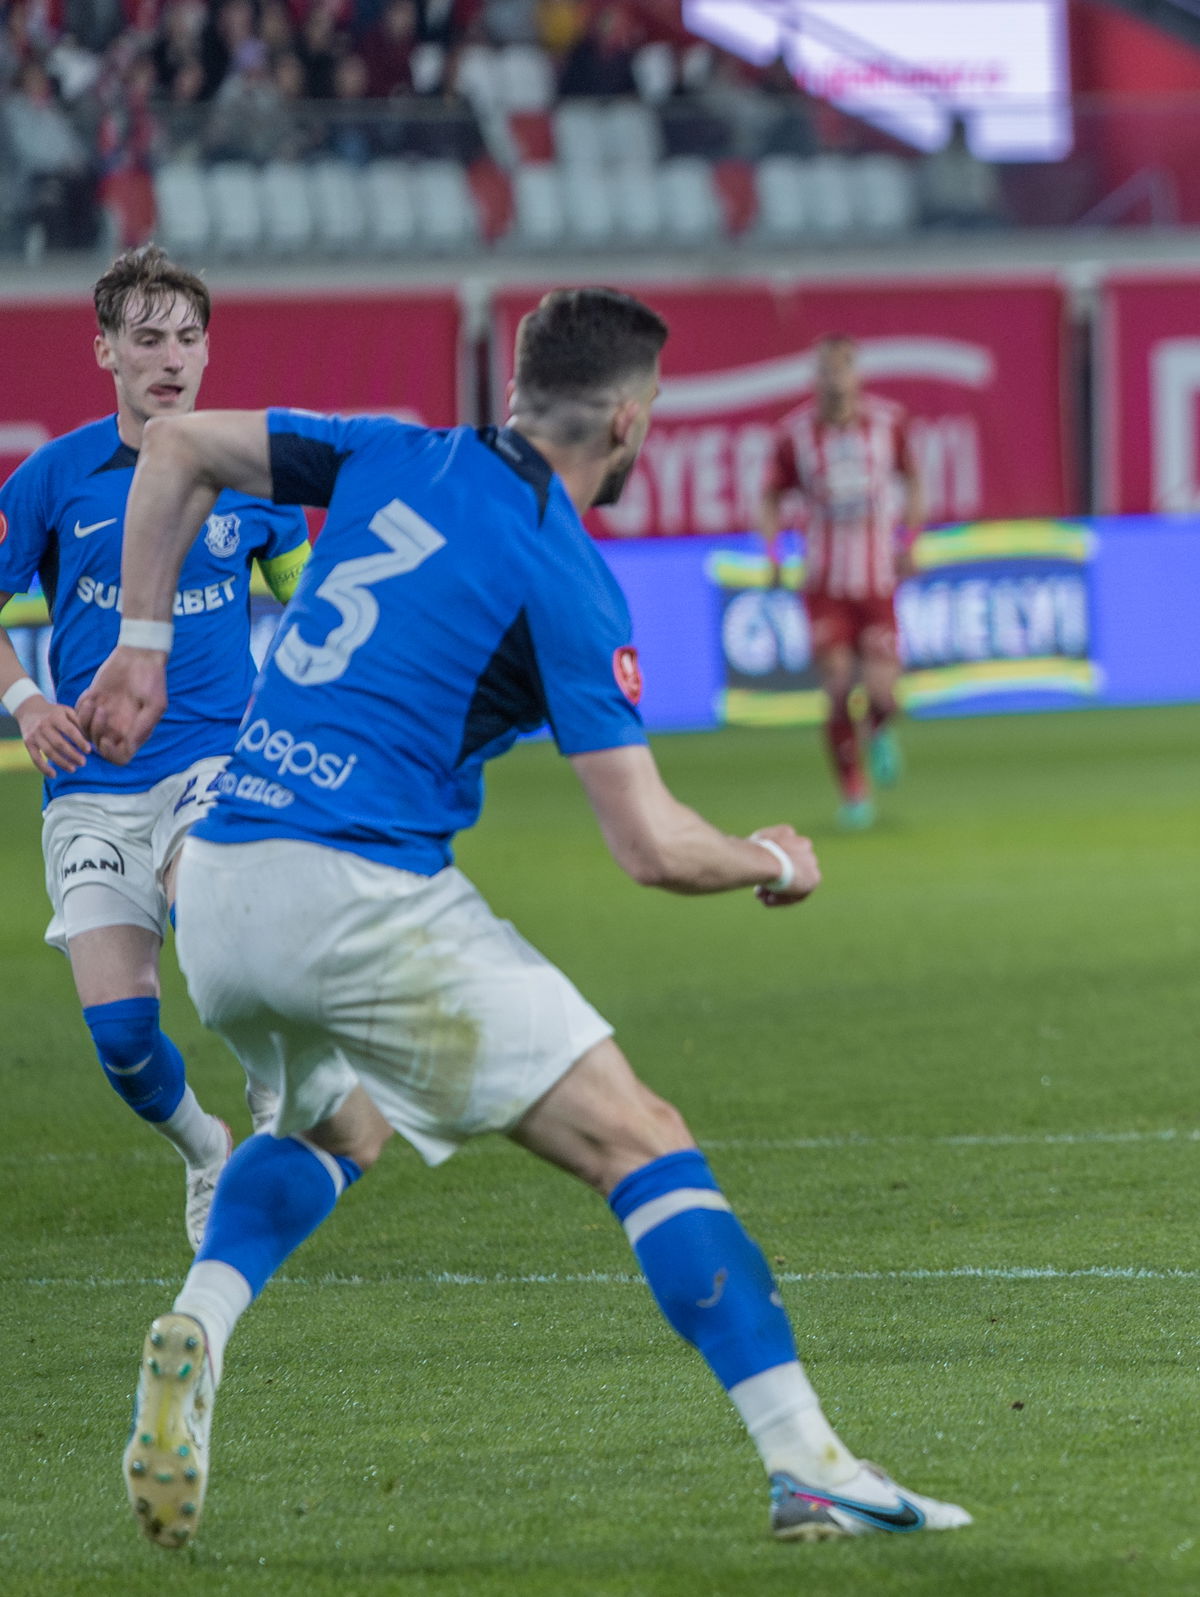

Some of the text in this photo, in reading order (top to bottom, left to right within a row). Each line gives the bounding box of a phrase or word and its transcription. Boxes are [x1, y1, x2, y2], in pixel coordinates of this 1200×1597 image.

[77, 575, 237, 617] SURBET
[274, 497, 448, 687] 3
[234, 717, 357, 790] pepsi
[63, 858, 120, 879] MAN
